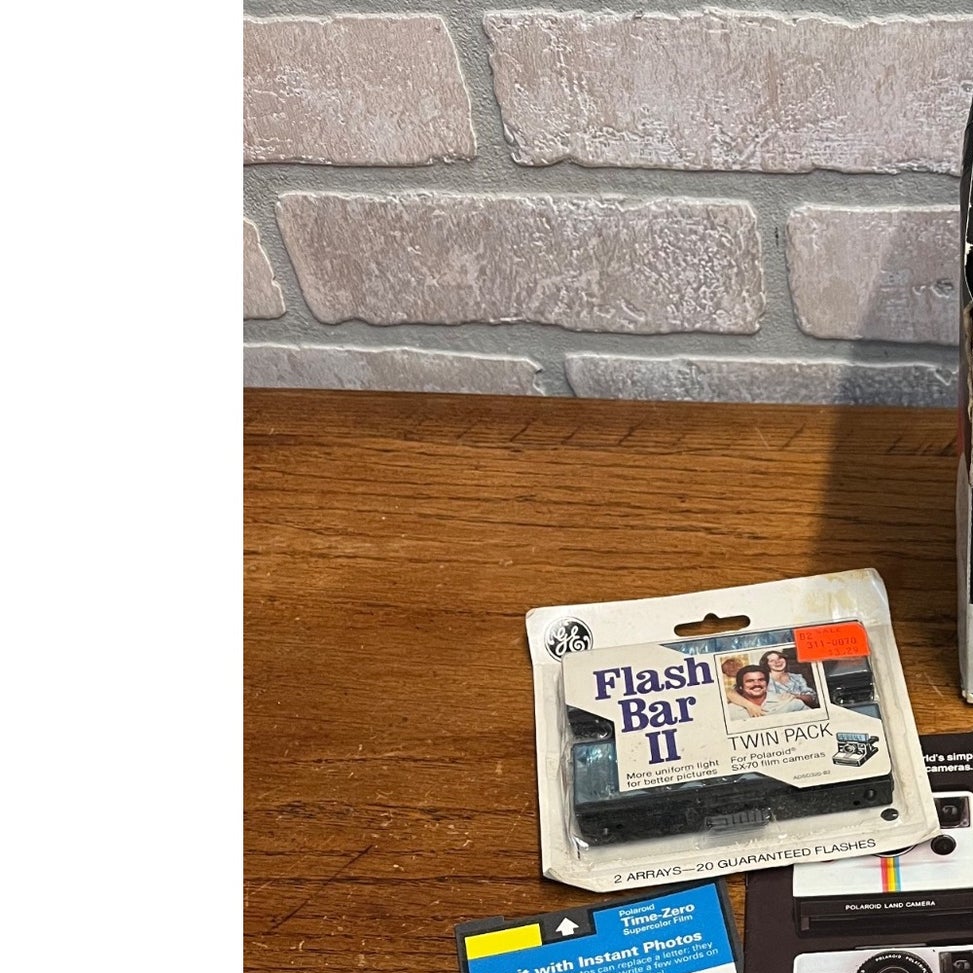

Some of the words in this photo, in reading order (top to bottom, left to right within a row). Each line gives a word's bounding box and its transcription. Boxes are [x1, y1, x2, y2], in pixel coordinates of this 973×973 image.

[593, 657, 715, 700] Flash
[618, 696, 697, 733] Bar
[644, 728, 682, 765] II
[727, 730, 778, 750] TWIN
[784, 722, 832, 742] PACK
[782, 752, 825, 763] cameras
[926, 764, 973, 772] cameras.
[626, 769, 651, 779] More
[655, 764, 694, 775] uniform
[696, 759, 718, 769] light
[643, 775, 673, 784] better
[676, 767, 717, 781] pictures
[614, 874, 621, 883] 2
[717, 847, 811, 868] GUARANTEED
[814, 838, 876, 854] FLASHES
[619, 903, 654, 916] Polaroid
[620, 904, 694, 926] Time-Zero
[623, 920, 670, 935] Supercolor
[672, 914, 692, 923] Film
[578, 946, 638, 967] Instant
[642, 932, 701, 953] Photos
[597, 965, 614, 973] can
[617, 956, 651, 968] replace
[692, 942, 712, 951] they
[653, 960, 671, 968] few
[674, 951, 703, 963] words
